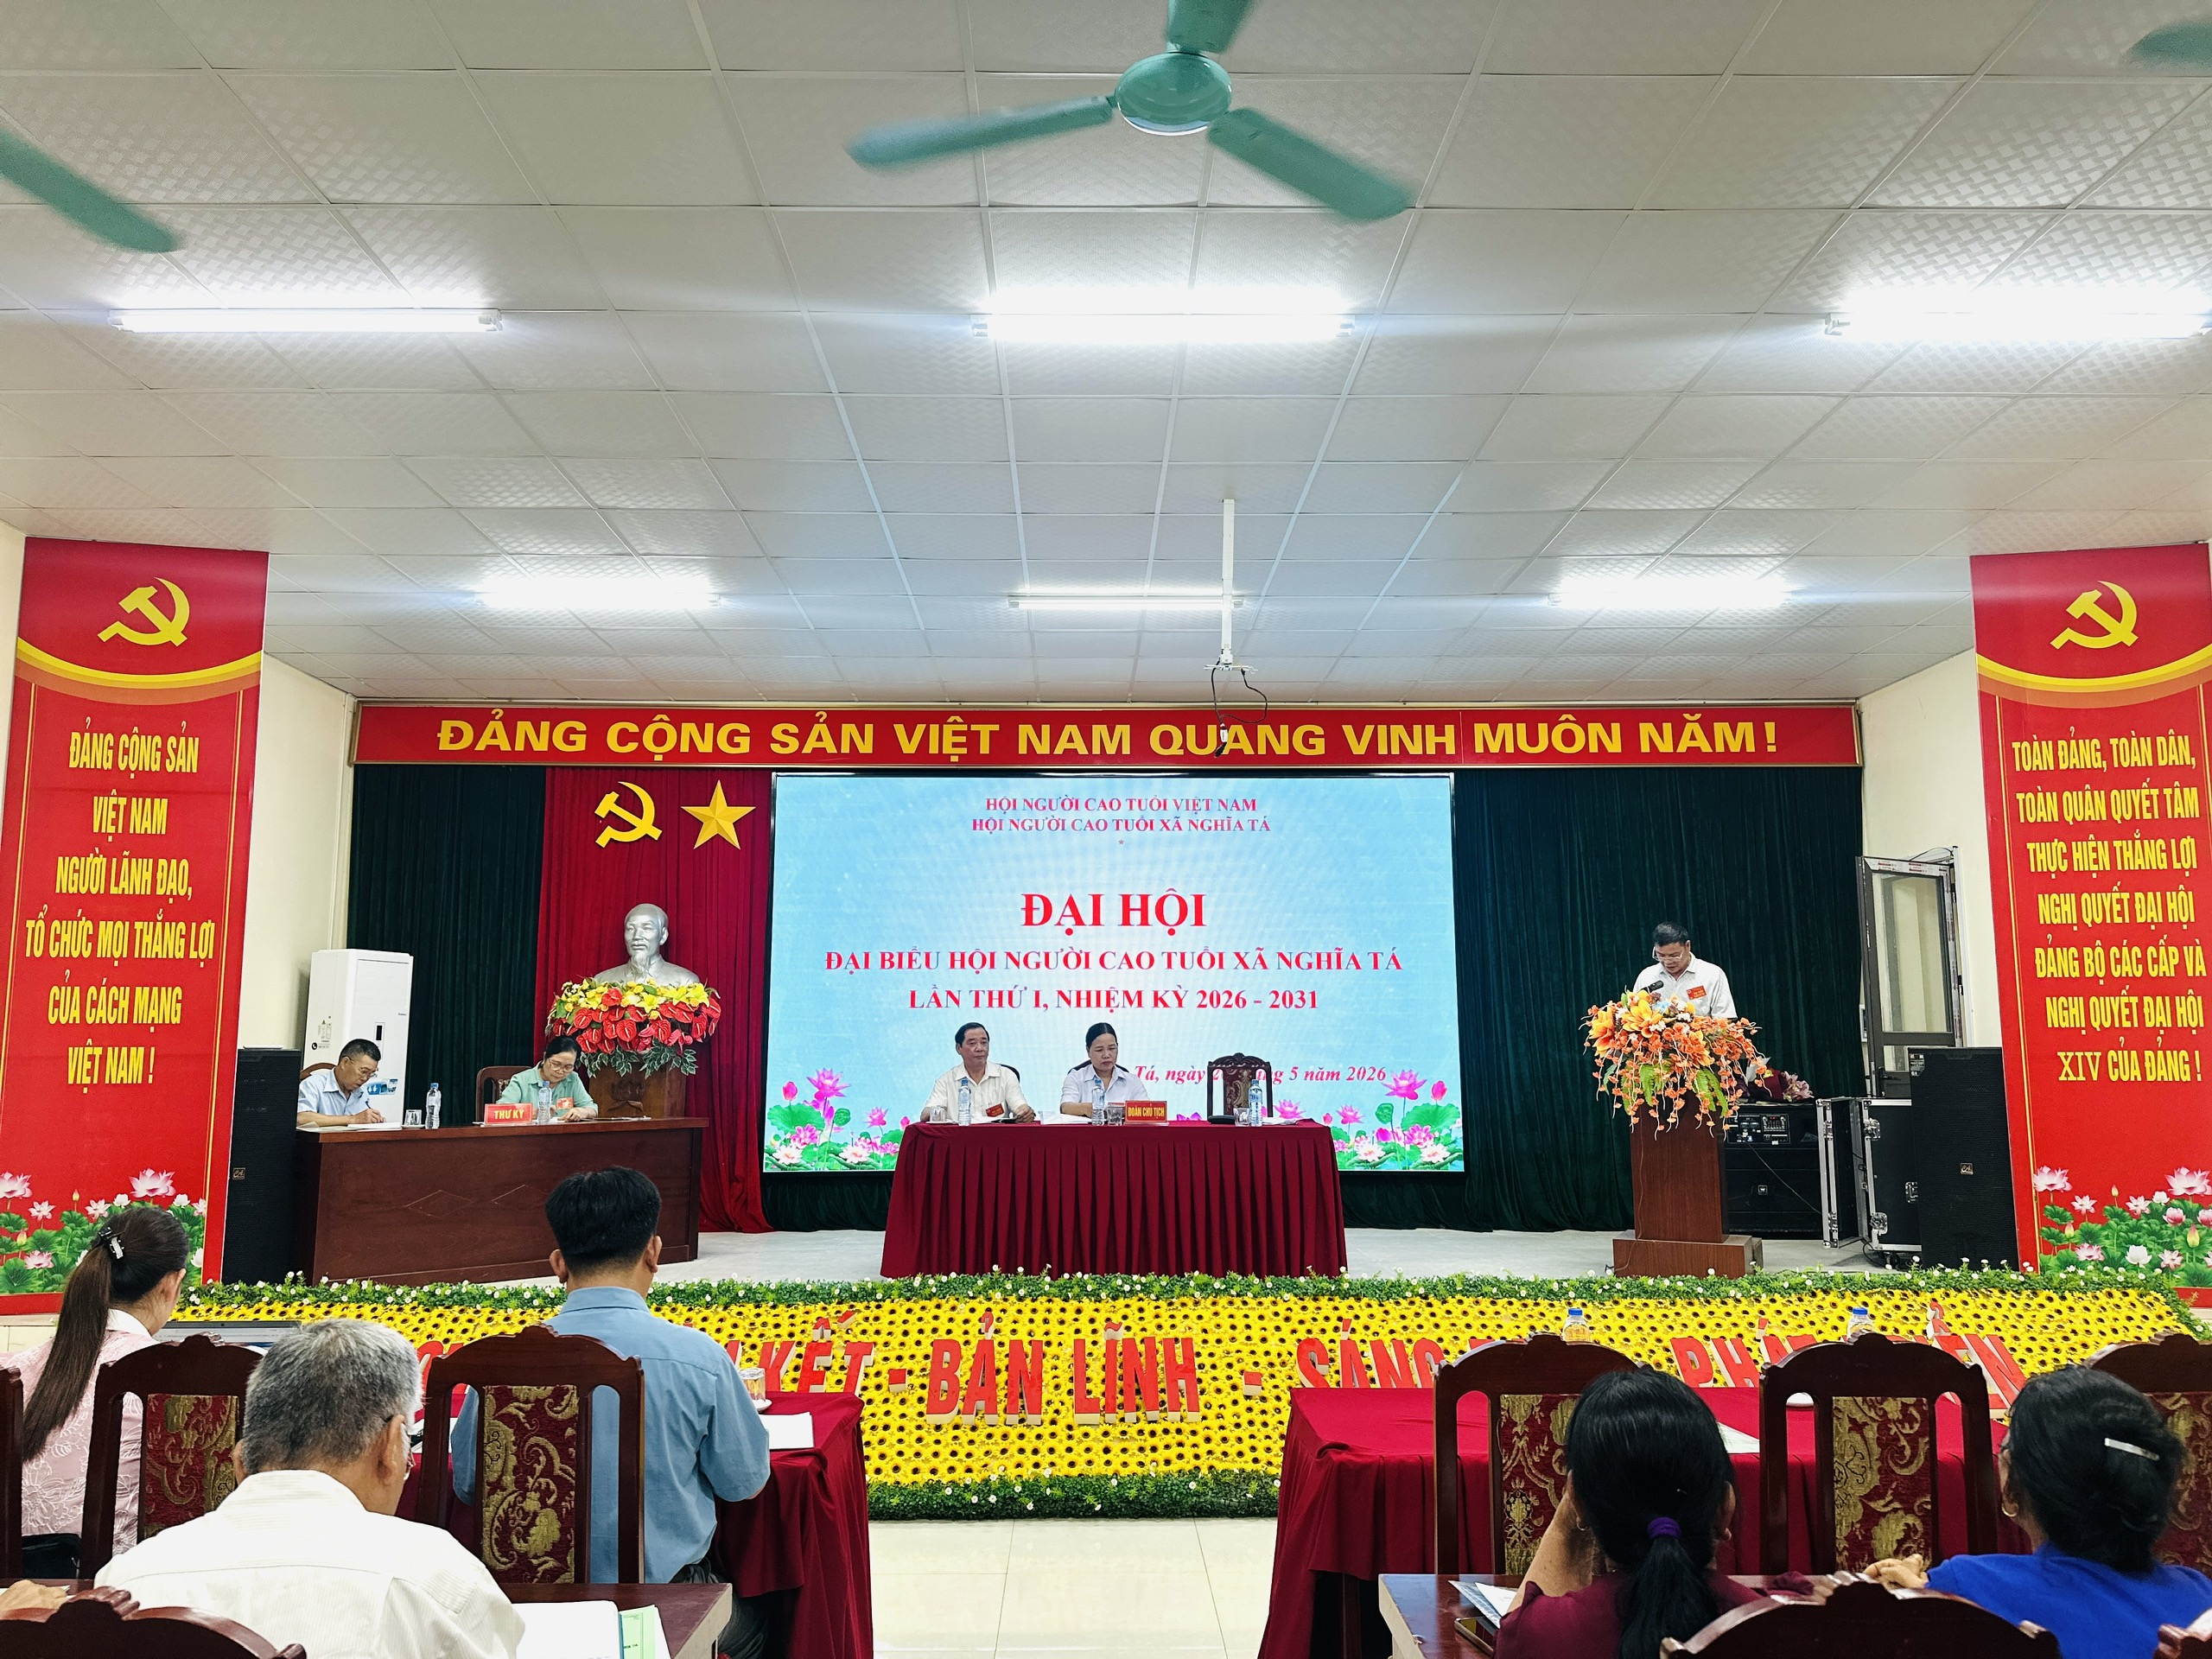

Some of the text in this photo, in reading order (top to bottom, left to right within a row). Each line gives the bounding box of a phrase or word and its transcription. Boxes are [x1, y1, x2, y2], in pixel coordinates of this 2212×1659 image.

[69, 718, 199, 779] ĐẢNG CỘNG SẢN
[436, 709, 588, 752] ĐẢNG
[607, 714, 751, 760] CỘNG
[770, 711, 874, 754] SẢN
[894, 716, 999, 761] VIỆT
[1019, 725, 1130, 754] NAM
[1150, 725, 1325, 755] QUANG
[1342, 725, 1455, 754] VINH
[1474, 715, 1621, 753] MUÔN
[1639, 714, 1755, 752] NĂM
[2012, 728, 2196, 771] TOÀN ĐẢNG, TOÀN DÂN,
[93, 789, 168, 842] VIỆT NAM
[971, 815, 1271, 835] HỘI NGƯỜI CAO TUỔI XÃ NGHĨA TÁ
[1022, 795, 1080, 811] NGƯỜI
[1084, 798, 1122, 811] CAO
[1172, 797, 1213, 815] VIỆT
[1217, 798, 1257, 811] NAM
[2016, 779, 2199, 824] TOÀN QUÂN QUYẾT TÂM
[55, 848, 192, 904] NGƯỜI LÃNH ĐẠO,
[2027, 830, 2197, 879] THỰC HIỆN THẮNG LỢI
[1020, 888, 1206, 936] ĐẠI HỘI
[2038, 882, 2195, 931] NGHỊ QUYẾT ĐẠI HỘI
[26, 905, 215, 967] TỔ CHỨC MỌI THẮNG LỢI
[824, 946, 1402, 975] ĐẠI BIỂU HỘI NGƯỜI CAO TUỔI XÃ NGHĨA TÁ
[2035, 934, 2207, 985] ĐẢNG BỘ CÁC CẤP VÀ
[48, 969, 181, 1032] CỦA CÁCH MẠNG
[909, 984, 961, 1008] LẦN
[969, 984, 1028, 1008] THỨ
[1033, 990, 1048, 1012] I,
[1056, 987, 1143, 1013] NHIỆM
[1152, 984, 1189, 1008] KỲ
[1197, 989, 1247, 1008] 2026
[1268, 989, 1318, 1008] 2031
[2046, 985, 2204, 1035] NGHỊ QUYẾT ĐẠI HỘI
[68, 1039, 103, 1093] VIỆT
[105, 1047, 144, 1084] NAM
[1166, 1065, 1205, 1084] ngày
[1289, 1065, 1300, 1081] 5
[1304, 1066, 1341, 1081] năm
[1345, 1065, 1387, 1081] 2026
[2057, 1052, 2101, 1080] XIV
[2107, 1037, 2141, 1081] CỦA
[2145, 1037, 2190, 1082] ĐẢNG
[494, 1109, 524, 1119] THƯ KÝ
[1128, 1103, 1165, 1119] ĐOÀN CHỦ TỊCH
[926, 1313, 1043, 1414] BẢN
[1073, 1322, 1199, 1414] LĨNH
